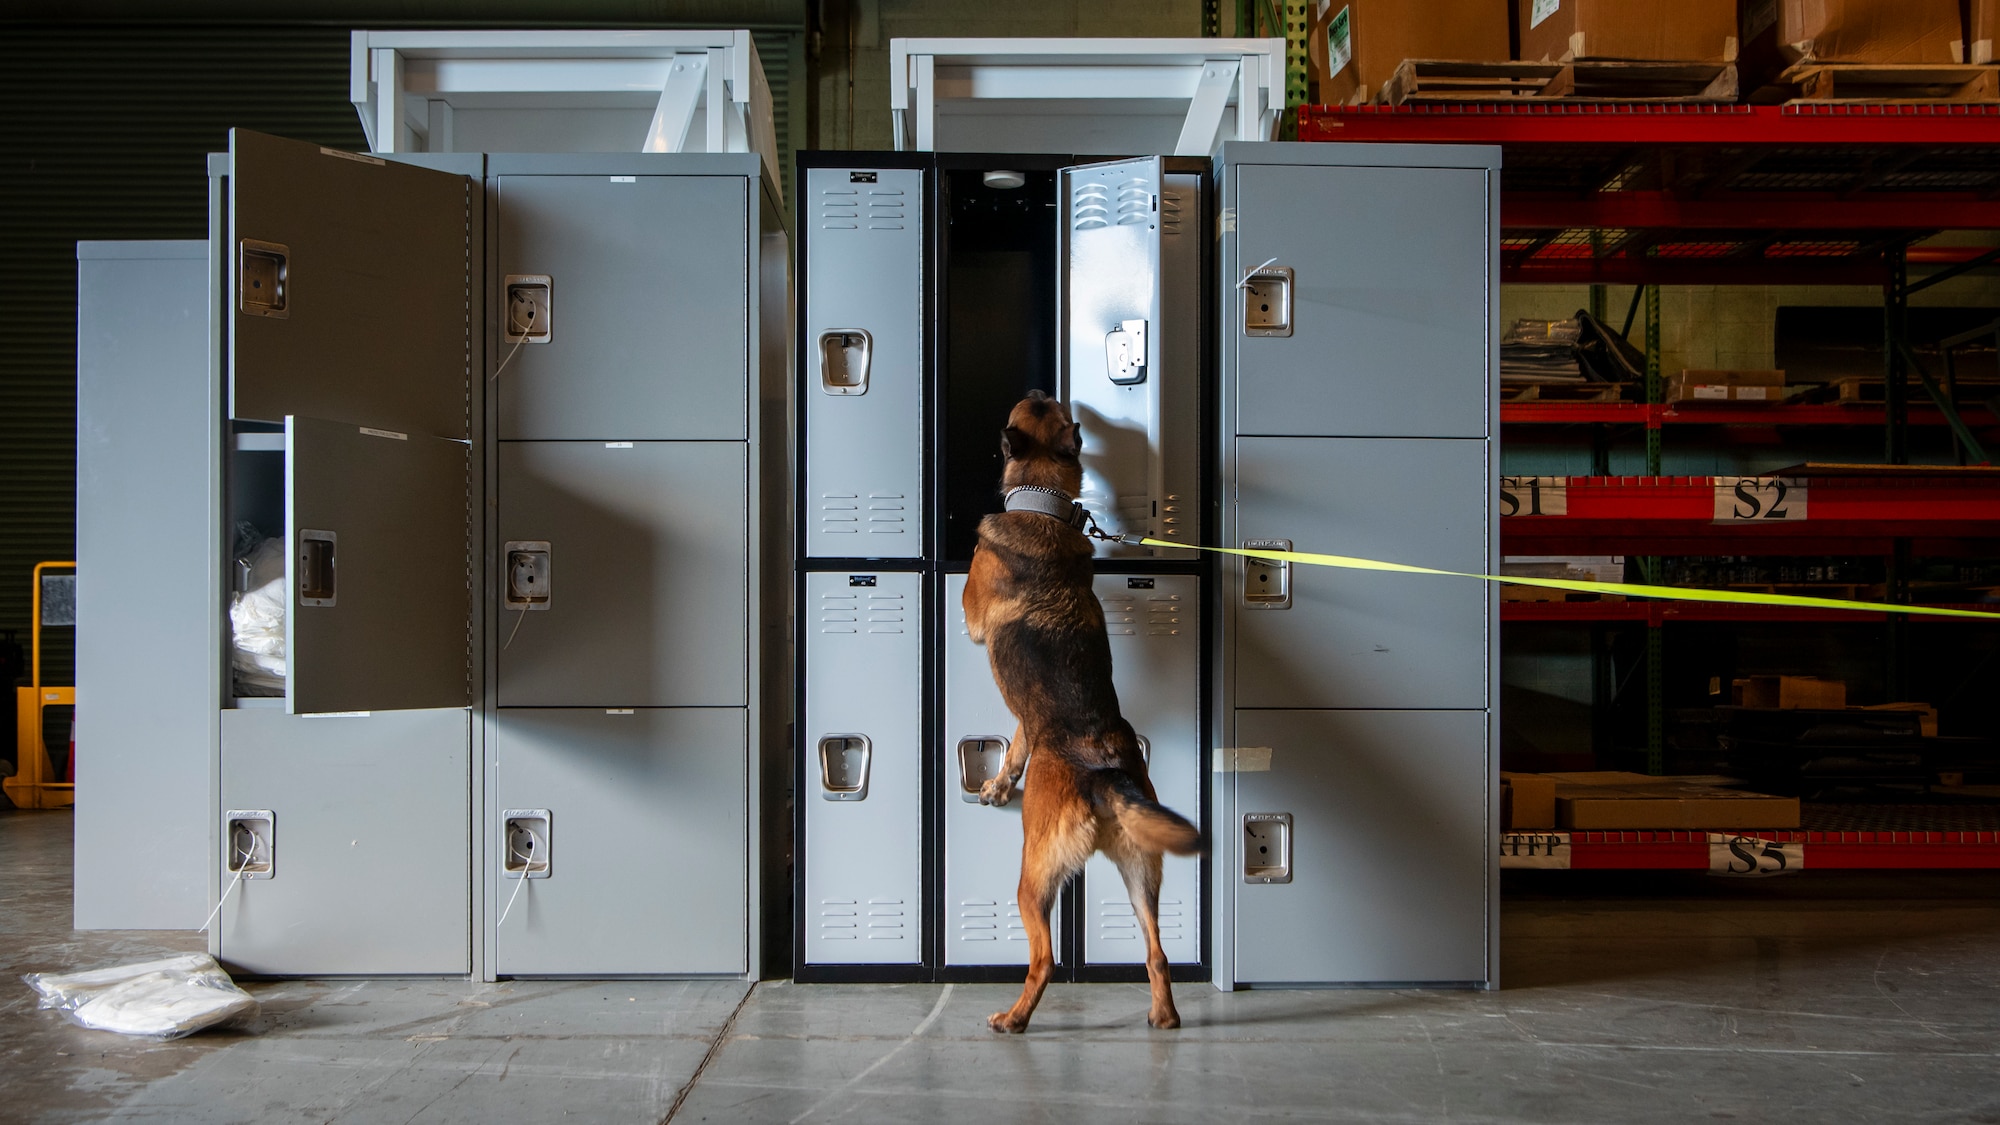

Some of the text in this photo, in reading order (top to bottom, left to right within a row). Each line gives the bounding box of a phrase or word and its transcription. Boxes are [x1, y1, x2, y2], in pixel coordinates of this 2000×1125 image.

[1500, 478, 1545, 516] S1
[1734, 480, 1788, 518] S2
[1500, 835, 1561, 857] TFP
[1728, 836, 1786, 873] S5
